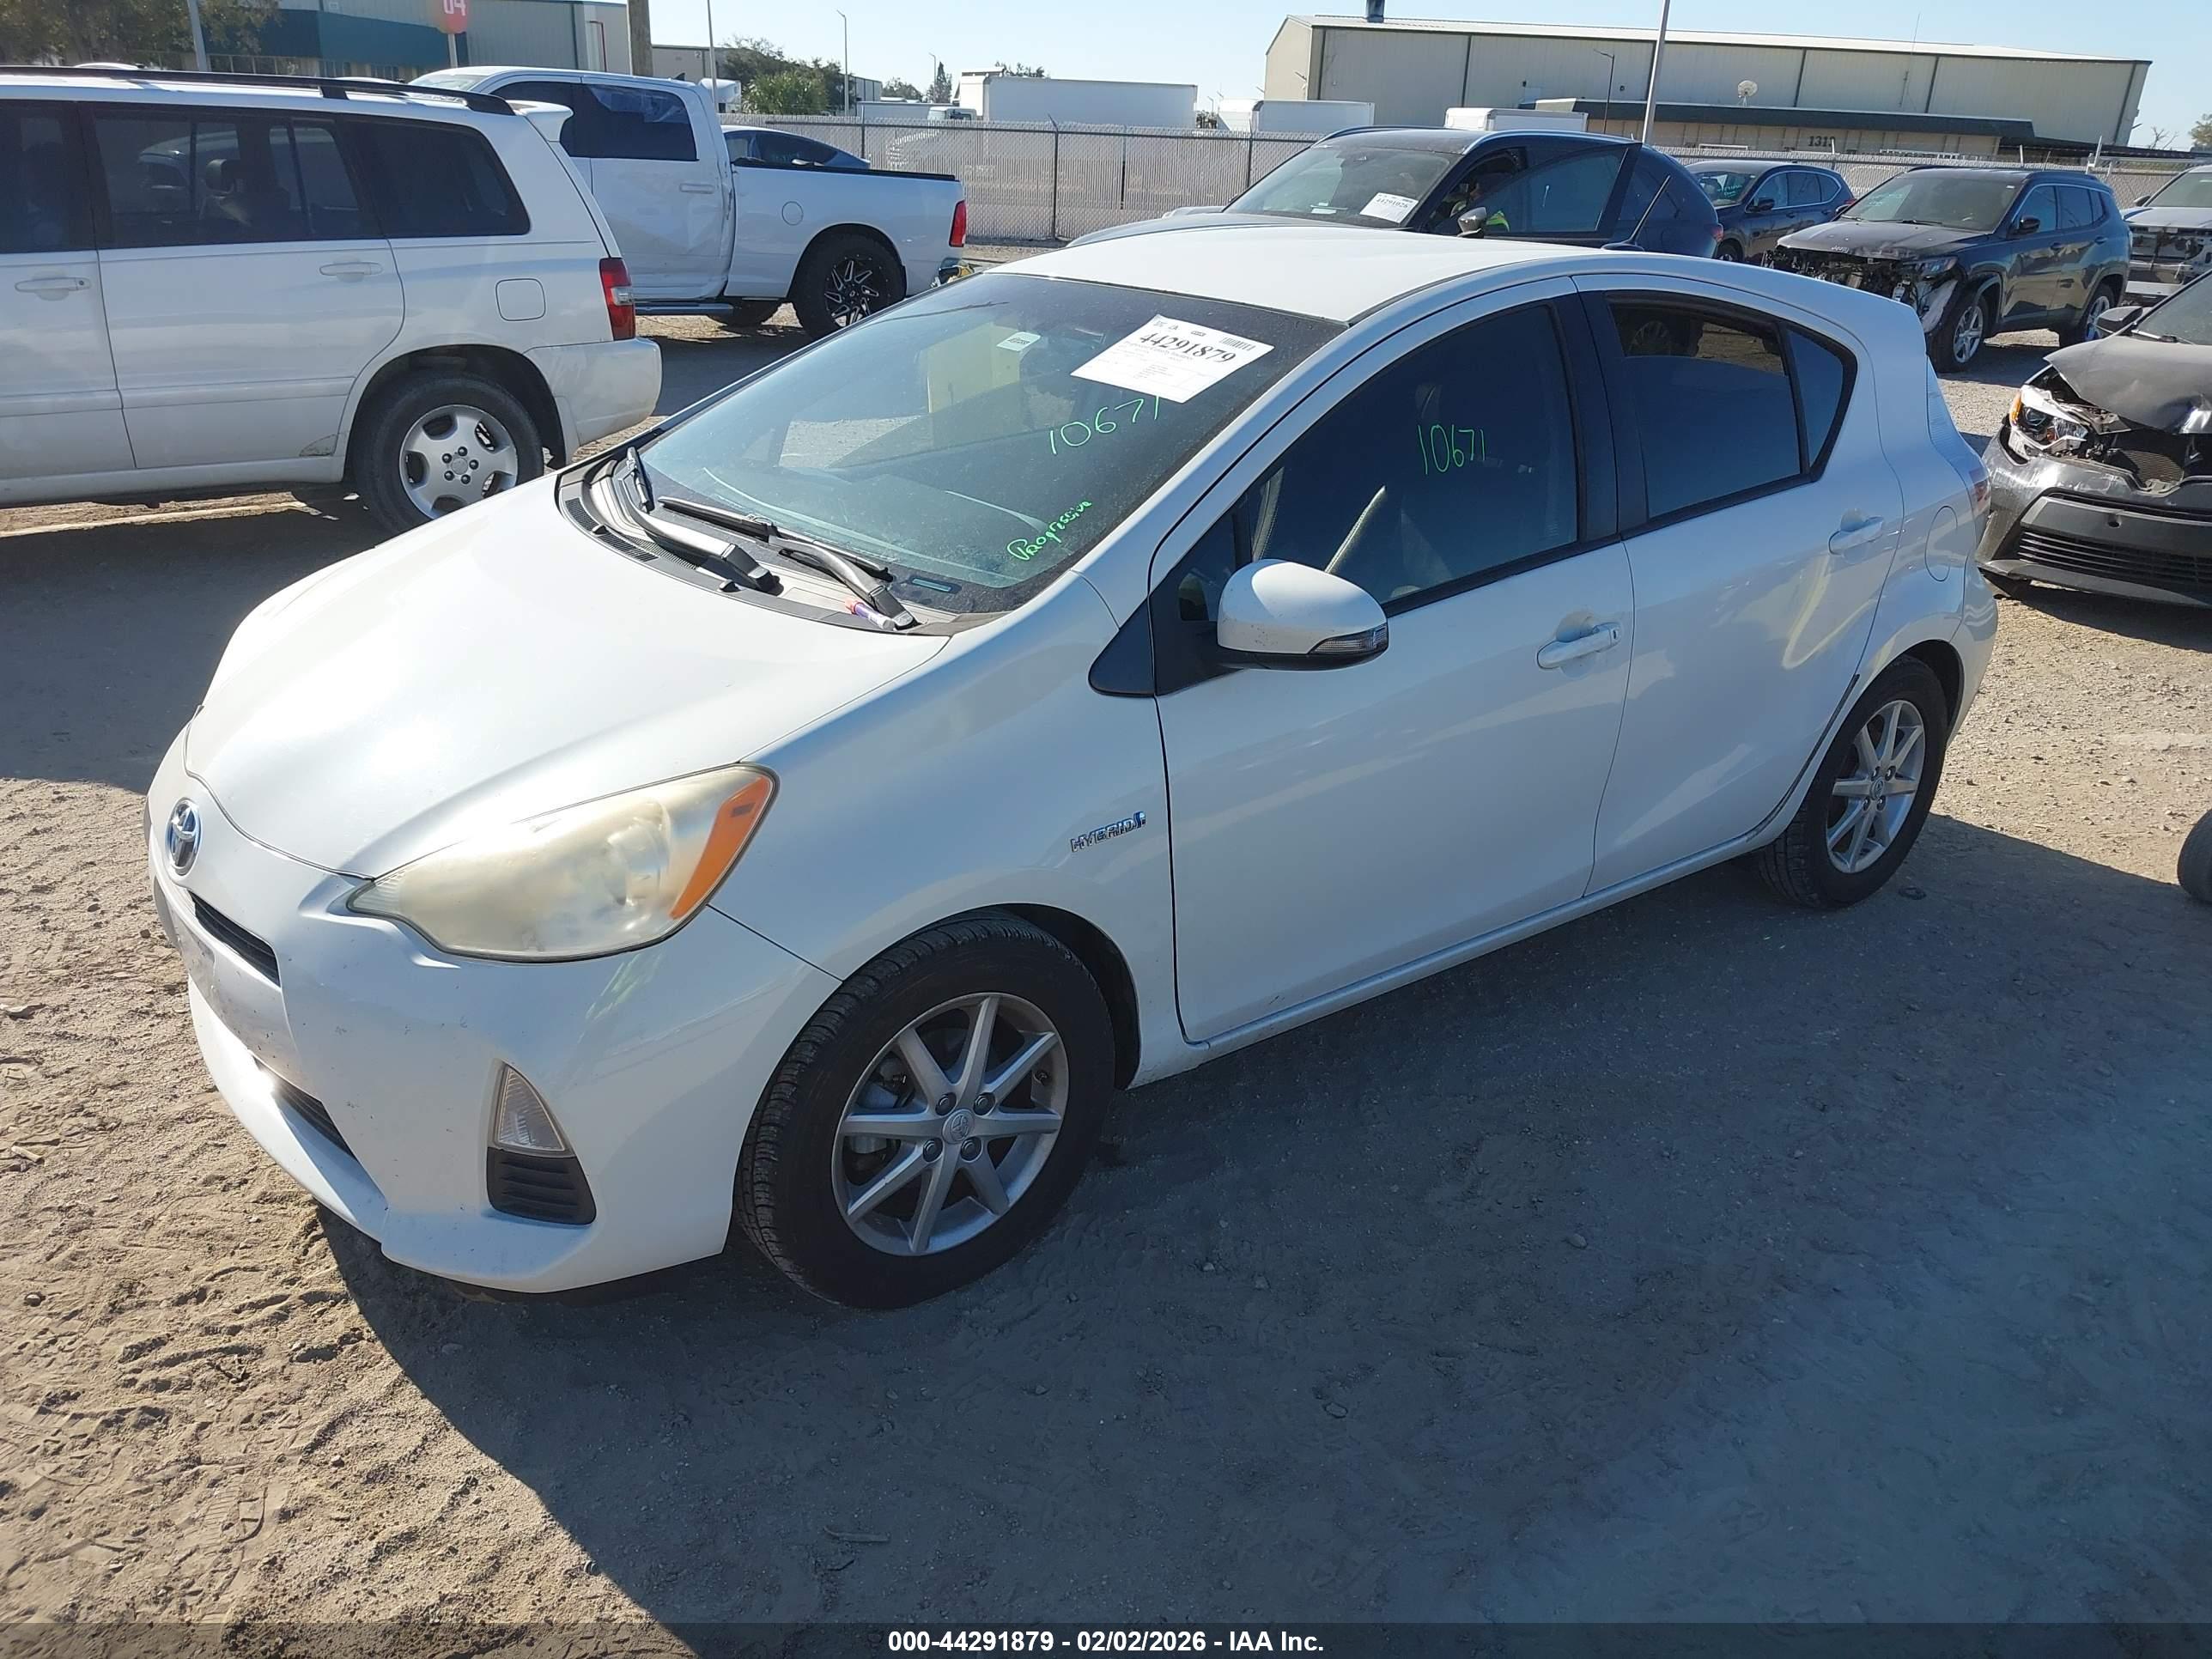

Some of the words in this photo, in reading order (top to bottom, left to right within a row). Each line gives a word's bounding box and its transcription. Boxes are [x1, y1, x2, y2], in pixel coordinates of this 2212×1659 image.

[1140, 332, 1237, 363] 44291879
[1049, 396, 1159, 454] 10671
[1417, 424, 1486, 475] 10671
[1070, 817, 1134, 852] HYBRID
